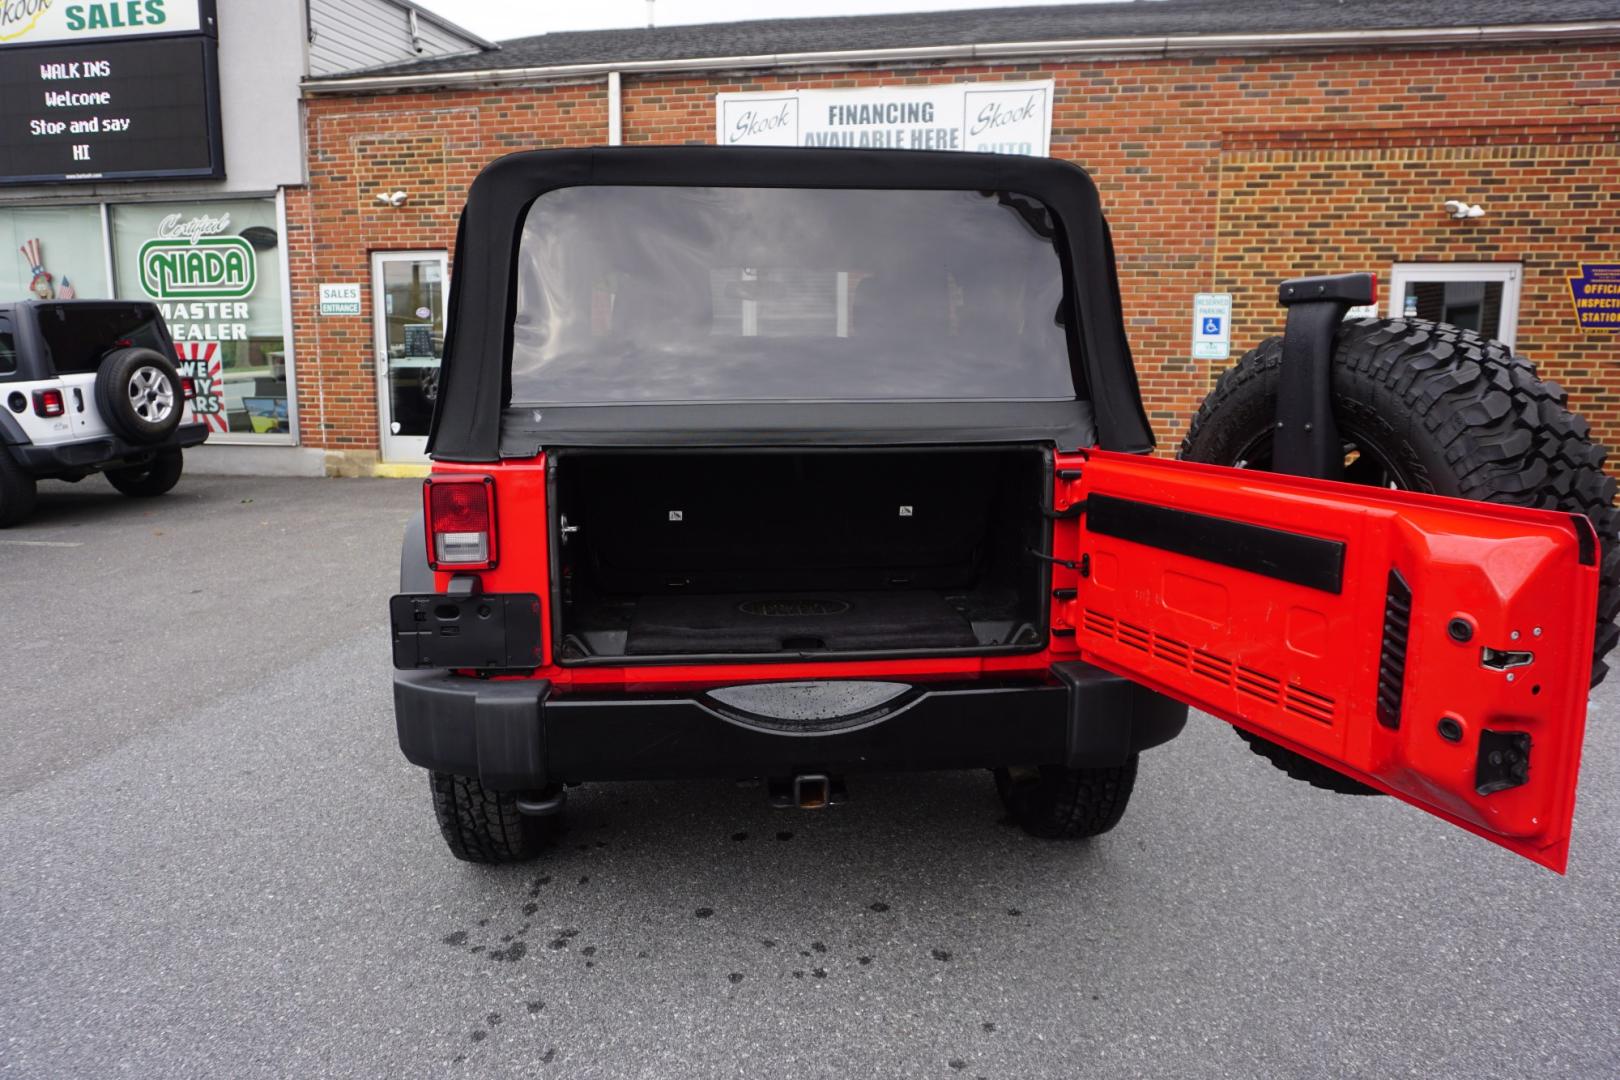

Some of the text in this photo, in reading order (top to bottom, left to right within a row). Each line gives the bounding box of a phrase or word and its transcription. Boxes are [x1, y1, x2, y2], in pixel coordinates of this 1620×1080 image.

[65, 0, 166, 31] SALES
[40, 60, 111, 80] WALK INS
[45, 91, 111, 107] Welcome
[730, 102, 789, 143] Skook
[828, 101, 934, 125] FINANCING
[970, 94, 1036, 136] Skook
[30, 116, 130, 135] Stop and say
[804, 128, 959, 149] AVAILABLE HERE
[72, 144, 91, 161] HI
[158, 212, 230, 246] Certified
[148, 249, 246, 298] NIADA
[323, 289, 357, 299] SALES
[156, 302, 249, 320] MASTER
[322, 303, 358, 312] ENTRANCE
[180, 361, 208, 378] WE
